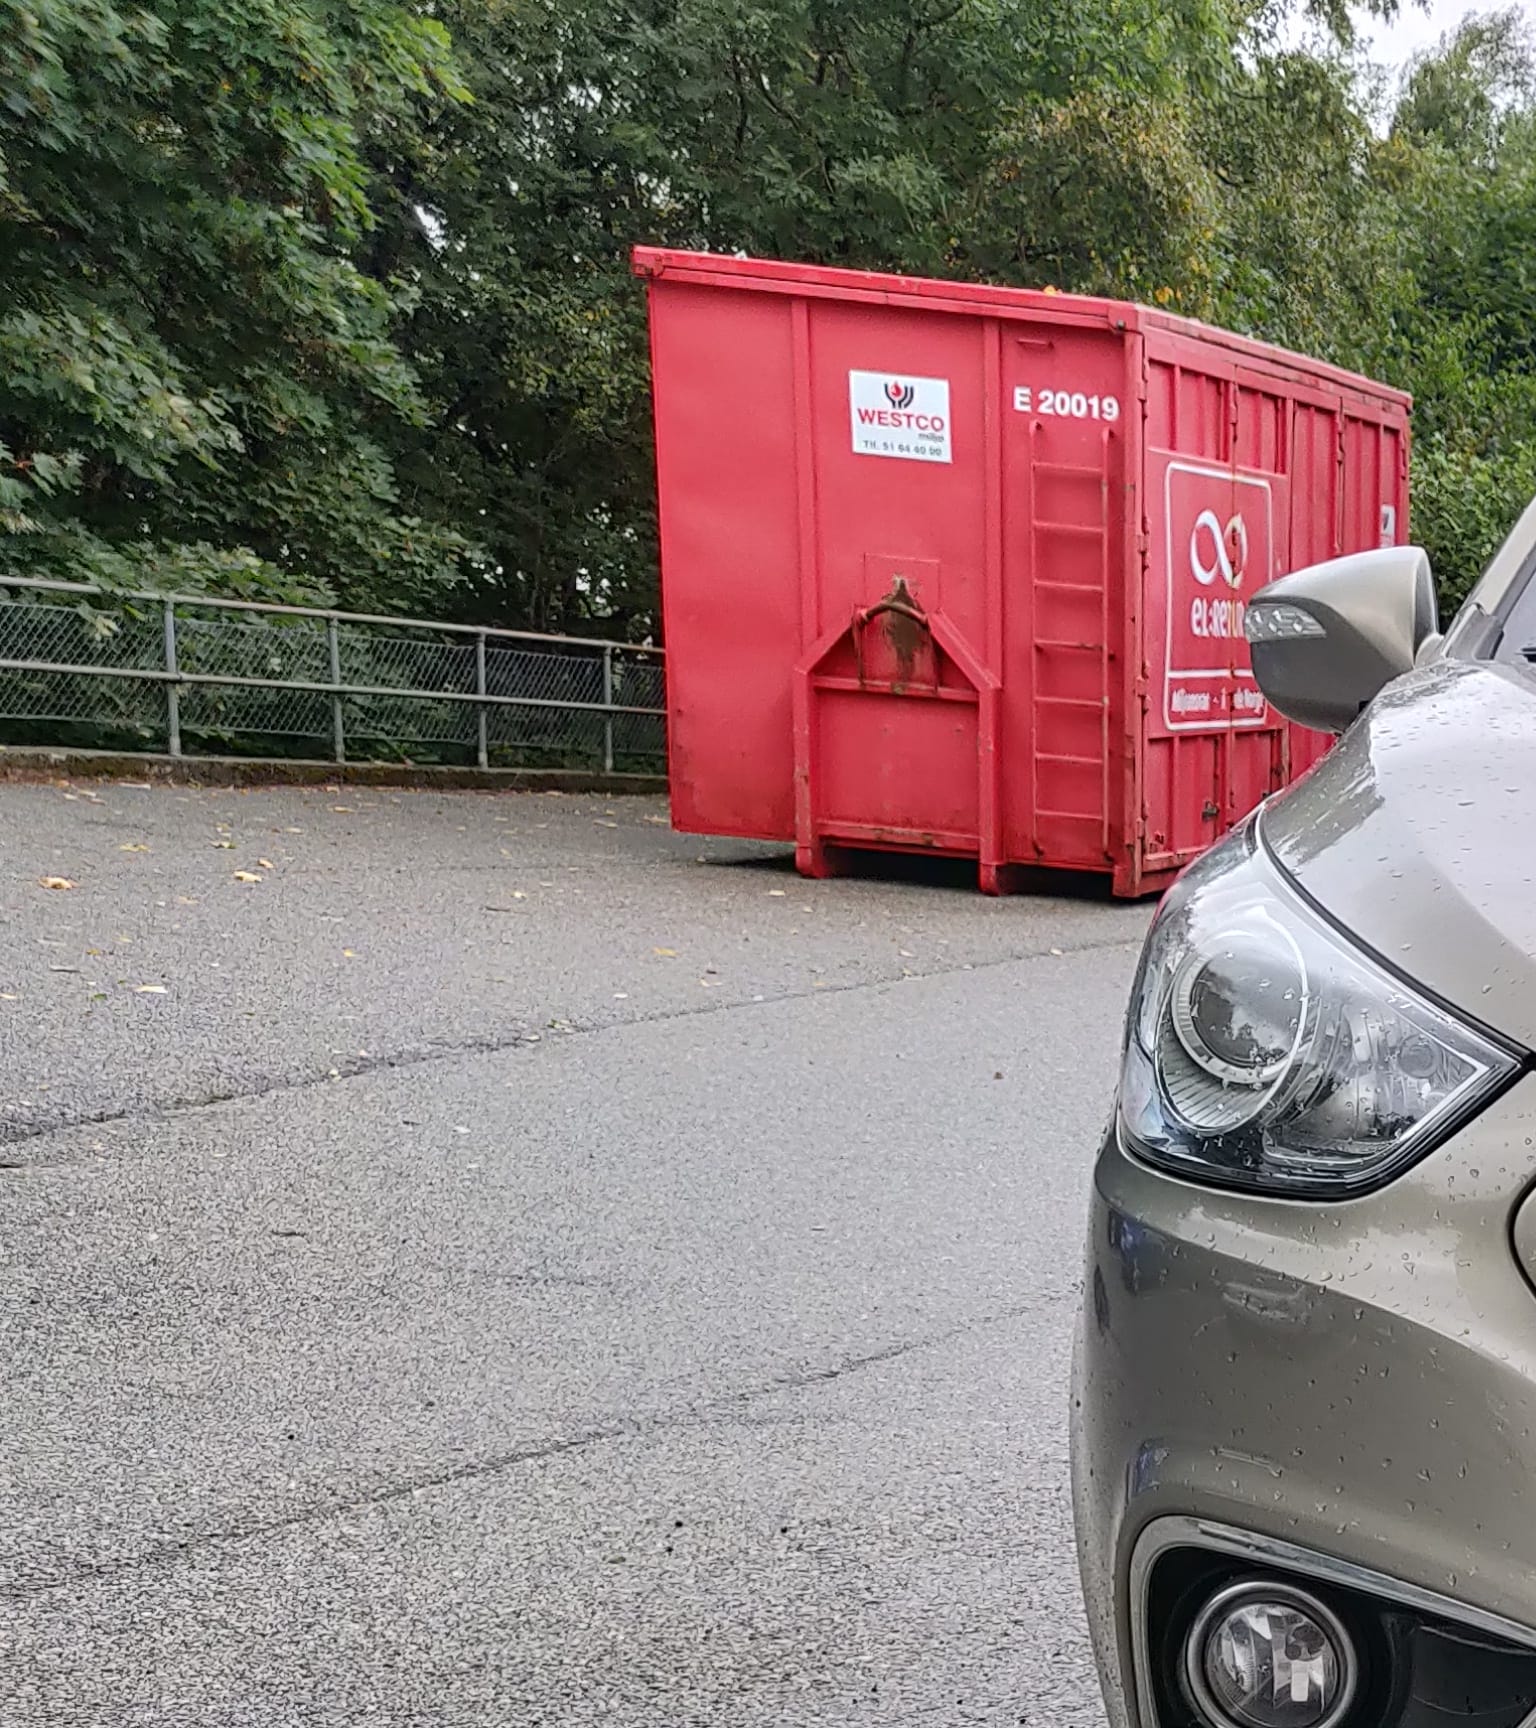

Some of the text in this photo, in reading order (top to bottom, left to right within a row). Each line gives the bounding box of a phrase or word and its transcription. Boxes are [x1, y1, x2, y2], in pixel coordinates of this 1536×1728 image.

[1013, 385, 1121, 422] E 20019
[857, 407, 945, 432] WESTCO
